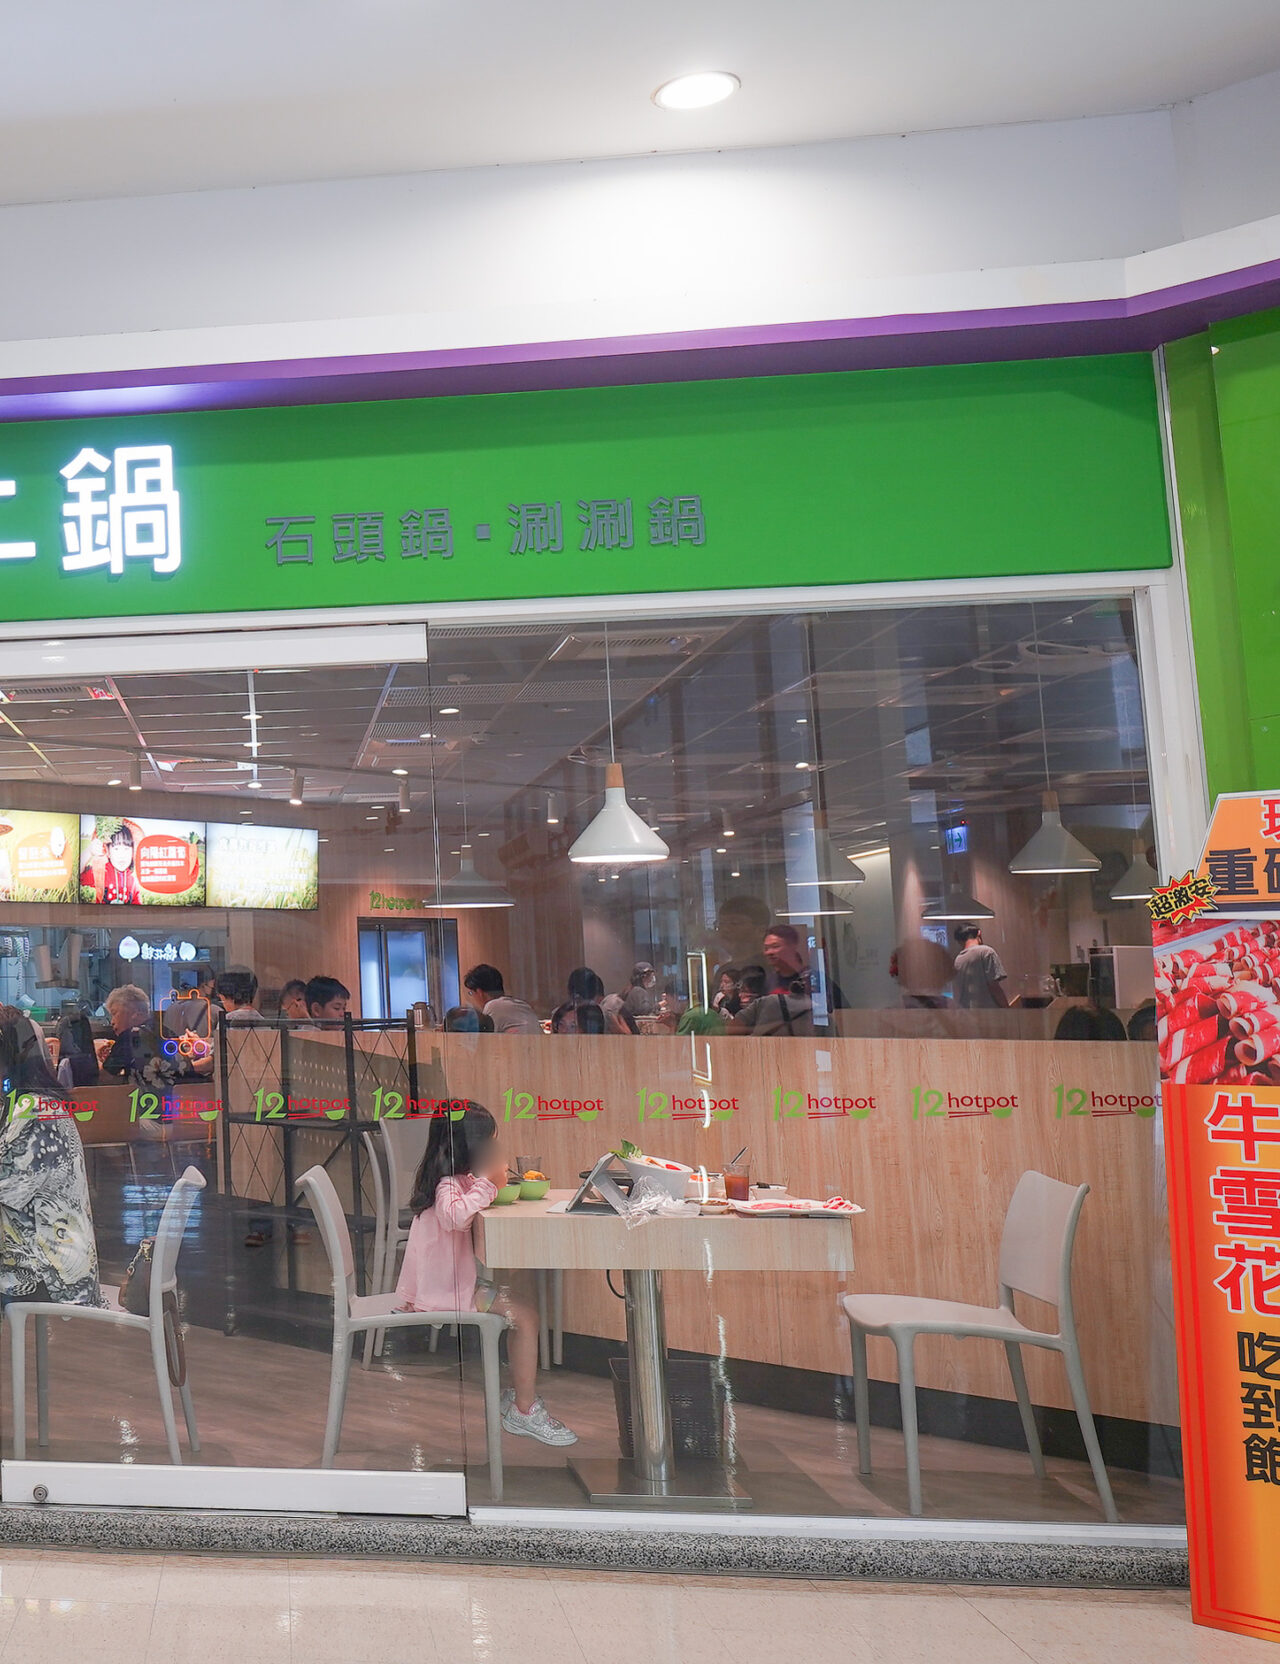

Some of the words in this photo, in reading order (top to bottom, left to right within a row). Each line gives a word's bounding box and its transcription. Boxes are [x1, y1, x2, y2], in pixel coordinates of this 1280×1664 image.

[1151, 878, 1212, 918] 超激安
[6, 1089, 37, 1122] 12
[38, 1097, 99, 1116] hotpot
[128, 1089, 160, 1122] 12
[161, 1097, 223, 1116] hotpot
[254, 1087, 286, 1121] 12
[288, 1096, 351, 1115] hotpot
[371, 1087, 404, 1121] 12
[406, 1095, 471, 1115] hotpot
[503, 1087, 536, 1122] 12
[537, 1096, 603, 1115] hotpot
[636, 1087, 670, 1121] 12
[671, 1095, 739, 1115] hotpot
[772, 1086, 805, 1121] 12
[807, 1094, 876, 1114] hotpot
[911, 1086, 946, 1120] 12
[947, 1092, 1018, 1113] hotpot
[1053, 1084, 1089, 1119] 12
[1091, 1091, 1162, 1112] hotpot
[1207, 1093, 1280, 1316] 牛雪花
